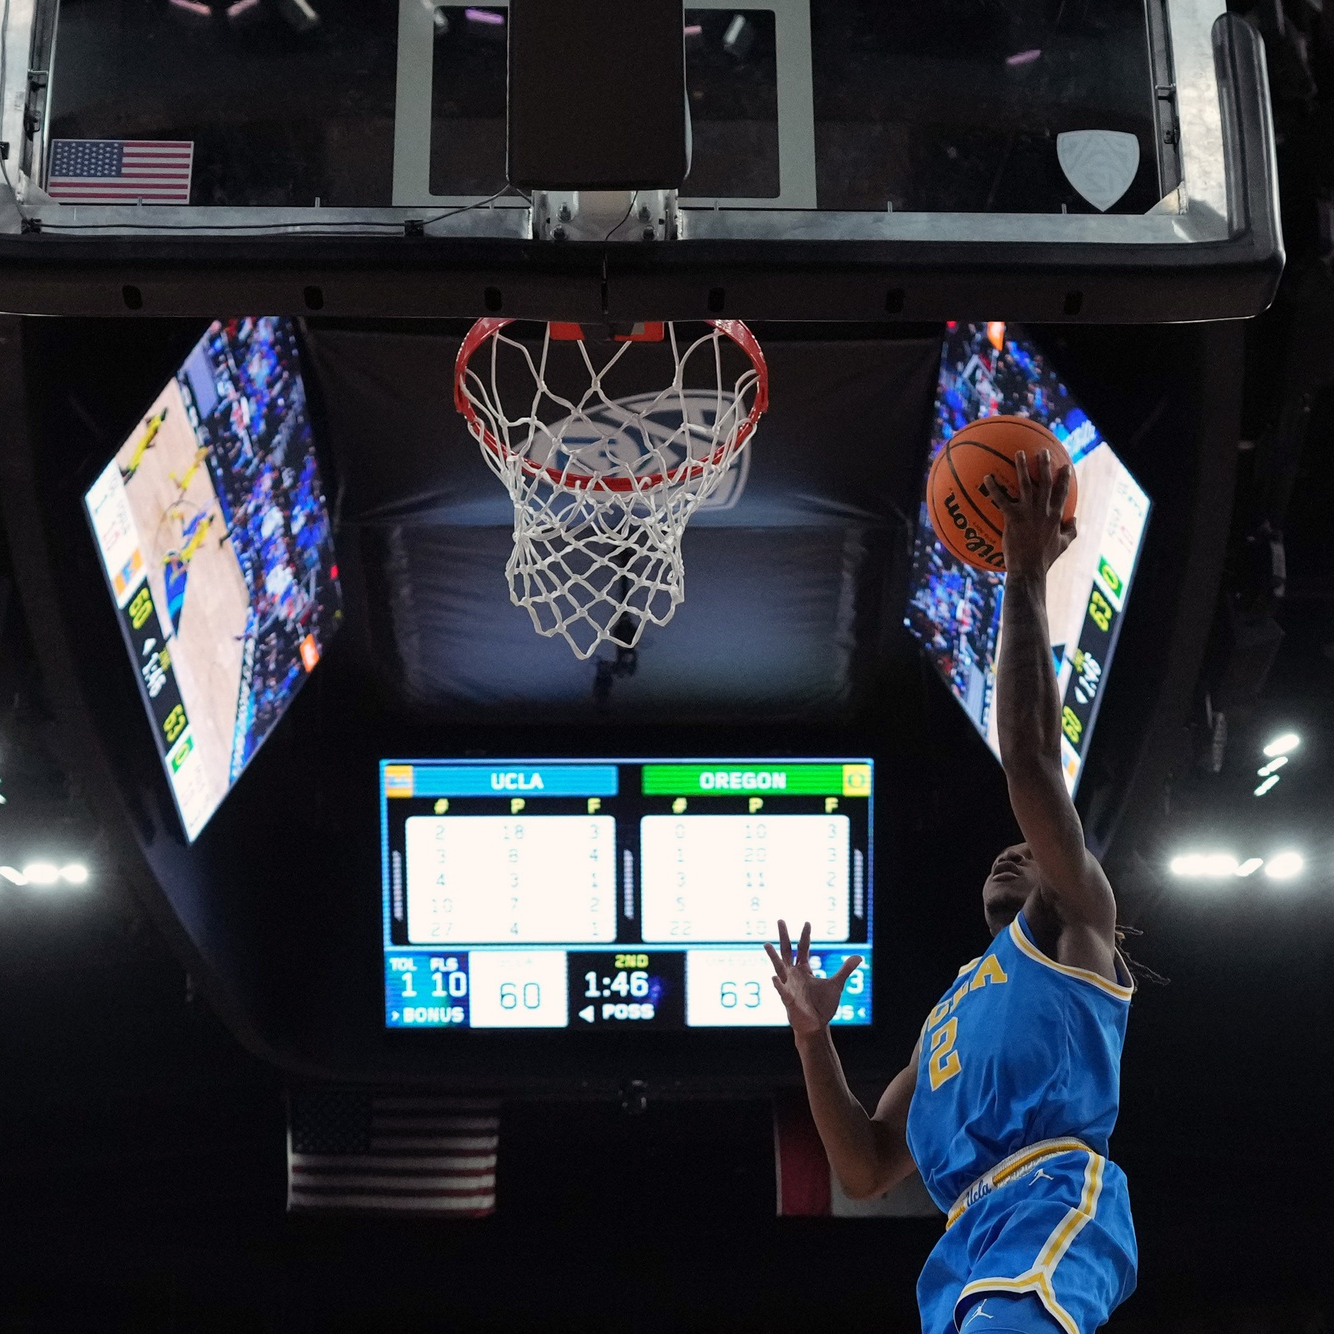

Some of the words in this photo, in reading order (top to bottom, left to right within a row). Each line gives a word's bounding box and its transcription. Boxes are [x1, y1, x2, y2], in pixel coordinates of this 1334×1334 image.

[490, 772, 545, 790] UCLA
[699, 771, 787, 790] OREGON
[510, 797, 526, 814] P
[587, 797, 601, 814] F
[748, 796, 764, 814] P
[824, 796, 839, 813] F
[435, 824, 445, 840] 2
[502, 824, 526, 840] 18
[590, 824, 601, 840] 3
[745, 823, 768, 840] 10
[508, 848, 520, 863] 8
[588, 848, 599, 863] 4
[676, 847, 685, 863] 1
[435, 872, 446, 887] 4
[591, 872, 600, 888] 1
[745, 871, 766, 887] 11
[826, 871, 837, 887] 2
[589, 897, 600, 912] 2
[749, 896, 761, 912] 8
[509, 921, 520, 935] 4
[591, 921, 600, 936] 1
[669, 920, 693, 936] 22
[826, 920, 837, 936] 2
[389, 957, 417, 972] TOL
[429, 957, 459, 972] FLS
[614, 954, 649, 968] 2ND
[401, 972, 417, 997] 1
[431, 971, 468, 998] 10
[584, 971, 649, 997] 1:46
[847, 969, 865, 995] 3
[499, 982, 541, 1010] 60
[720, 981, 761, 1008] 63
[403, 1006, 465, 1024] BONUS
[601, 1004, 655, 1020] POSS
